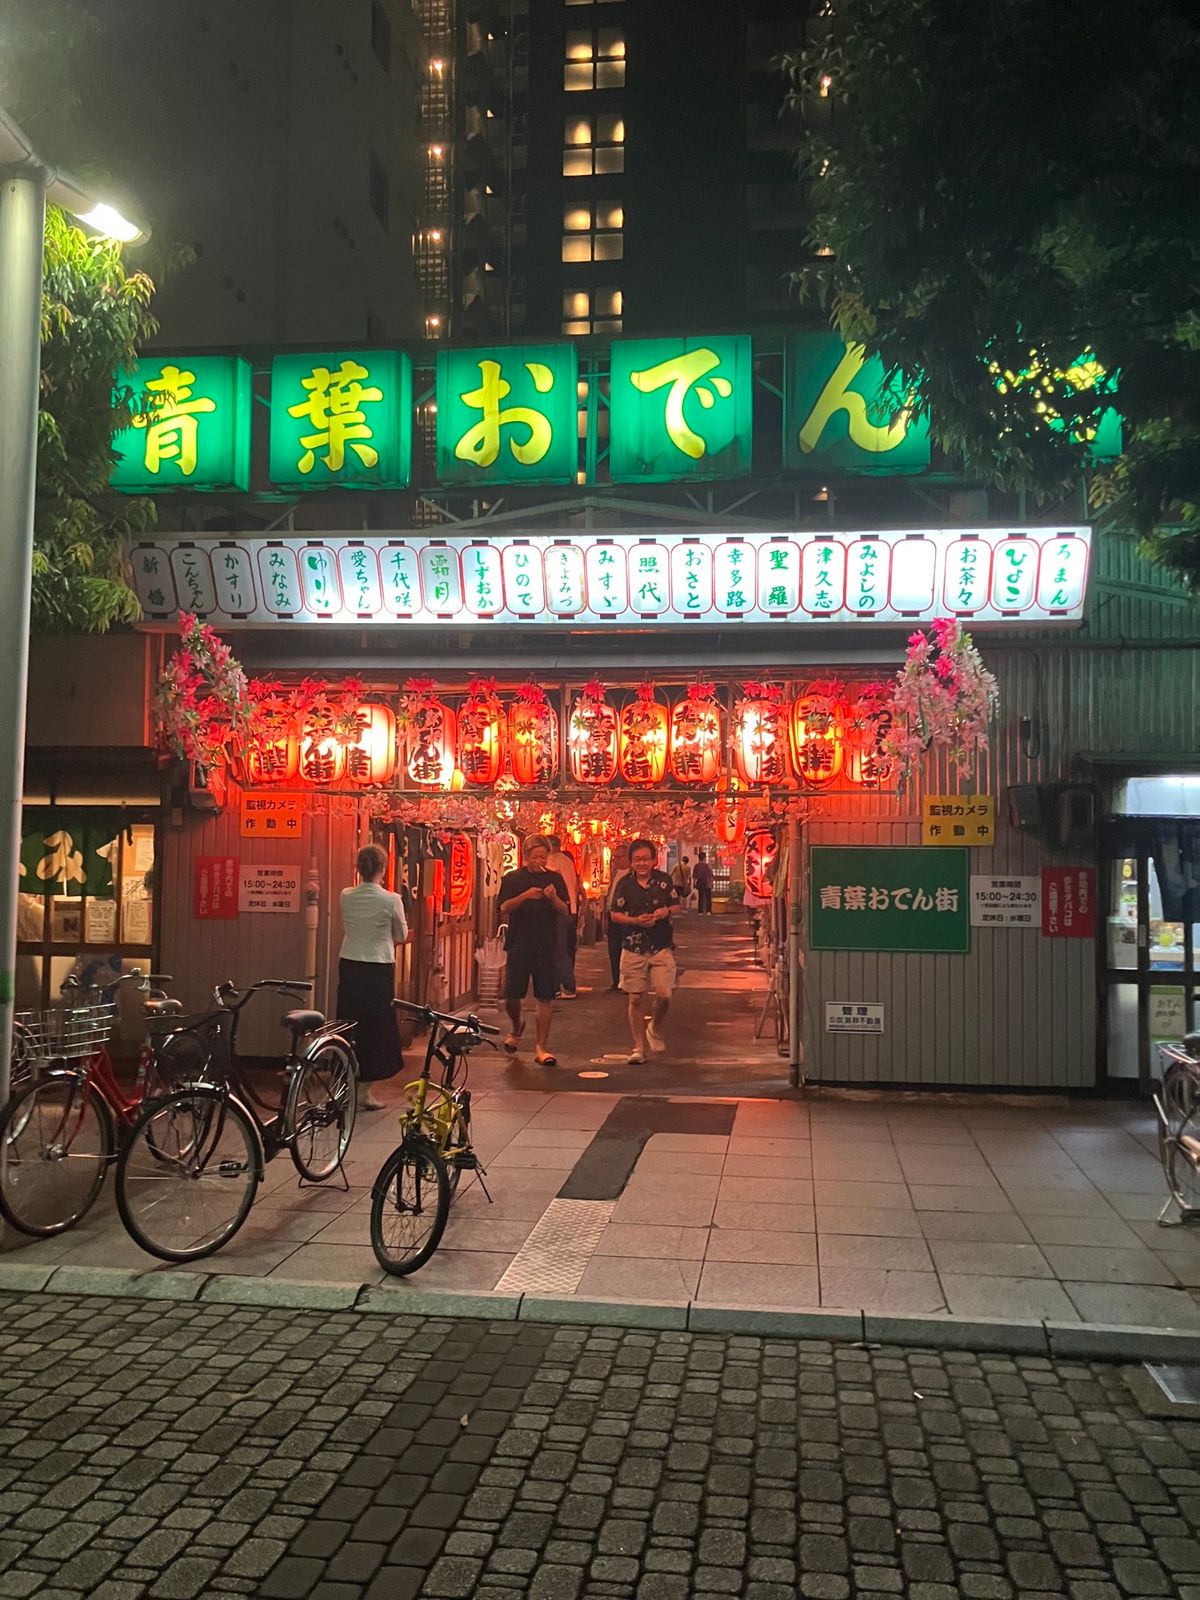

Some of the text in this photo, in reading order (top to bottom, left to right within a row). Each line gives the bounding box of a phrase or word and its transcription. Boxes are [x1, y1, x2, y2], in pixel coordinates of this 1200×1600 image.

[132, 341, 1107, 475] 青葉おでん
[182, 553, 204, 609] こんちゃん
[224, 554, 243, 609] かすり
[269, 553, 291, 608] みなみ
[351, 550, 370, 609] 愛ちゃん
[390, 551, 413, 608] 千代咲
[474, 551, 494, 609] しずおか
[514, 553, 532, 607] ひので
[638, 557, 662, 603] 照代
[685, 548, 704, 609] おさと
[726, 548, 747, 608] 幸多路
[768, 549, 789, 606] 聖羅
[815, 547, 833, 609] 津久志
[858, 544, 877, 609] みよしの
[958, 547, 978, 606] お茶々
[1050, 544, 1071, 605] ろまん
[246, 800, 297, 811] 監視カメラ
[929, 804, 988, 816] 監視カメラ
[820, 885, 959, 912] 青葉おでん街
